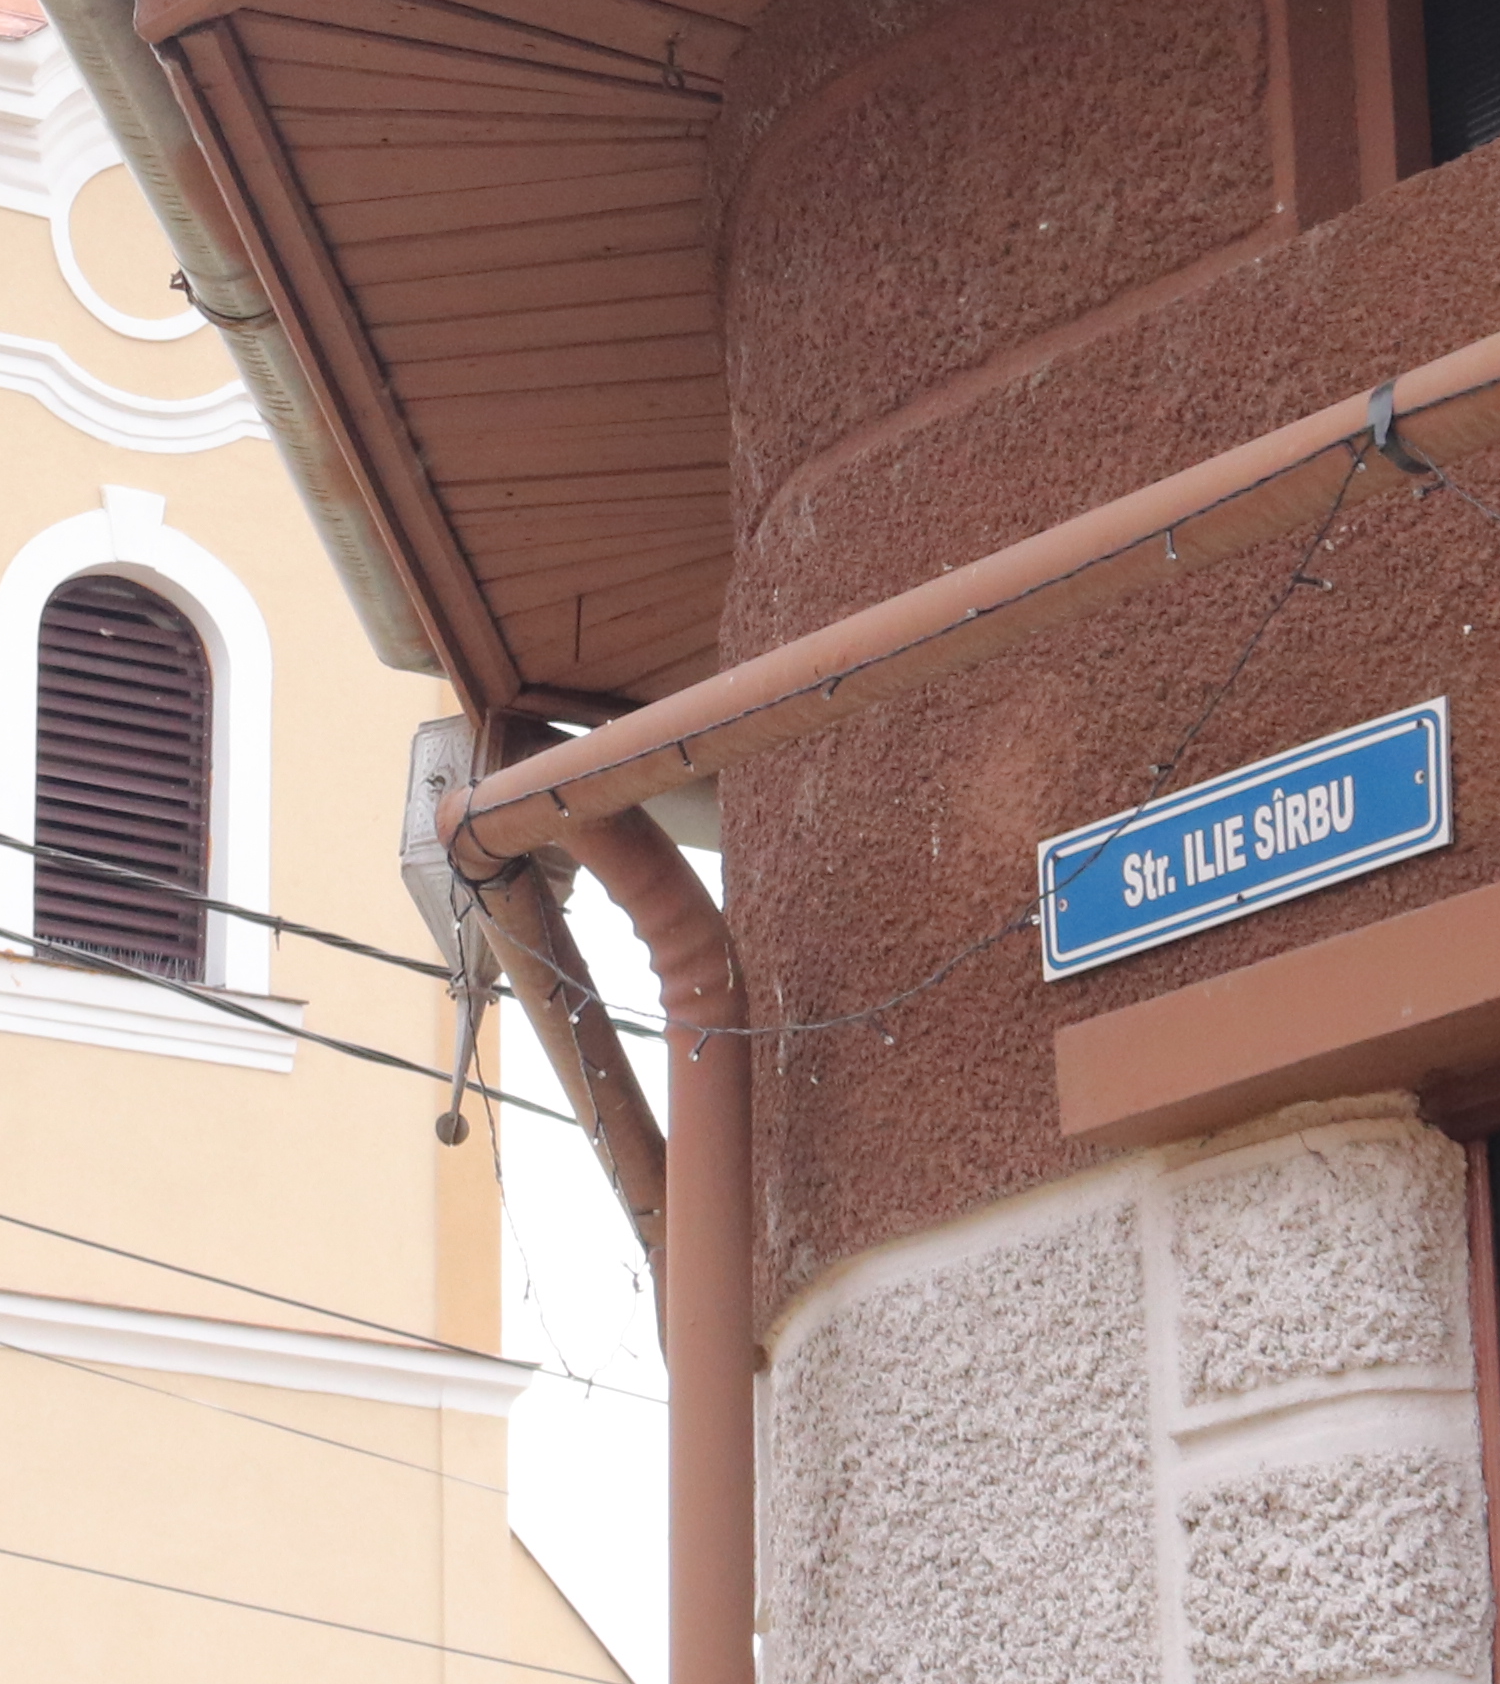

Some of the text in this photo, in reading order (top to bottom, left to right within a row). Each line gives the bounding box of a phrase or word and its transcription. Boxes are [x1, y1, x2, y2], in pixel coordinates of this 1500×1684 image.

[1123, 776, 1354, 907] Str. ILIE SÎRBU
